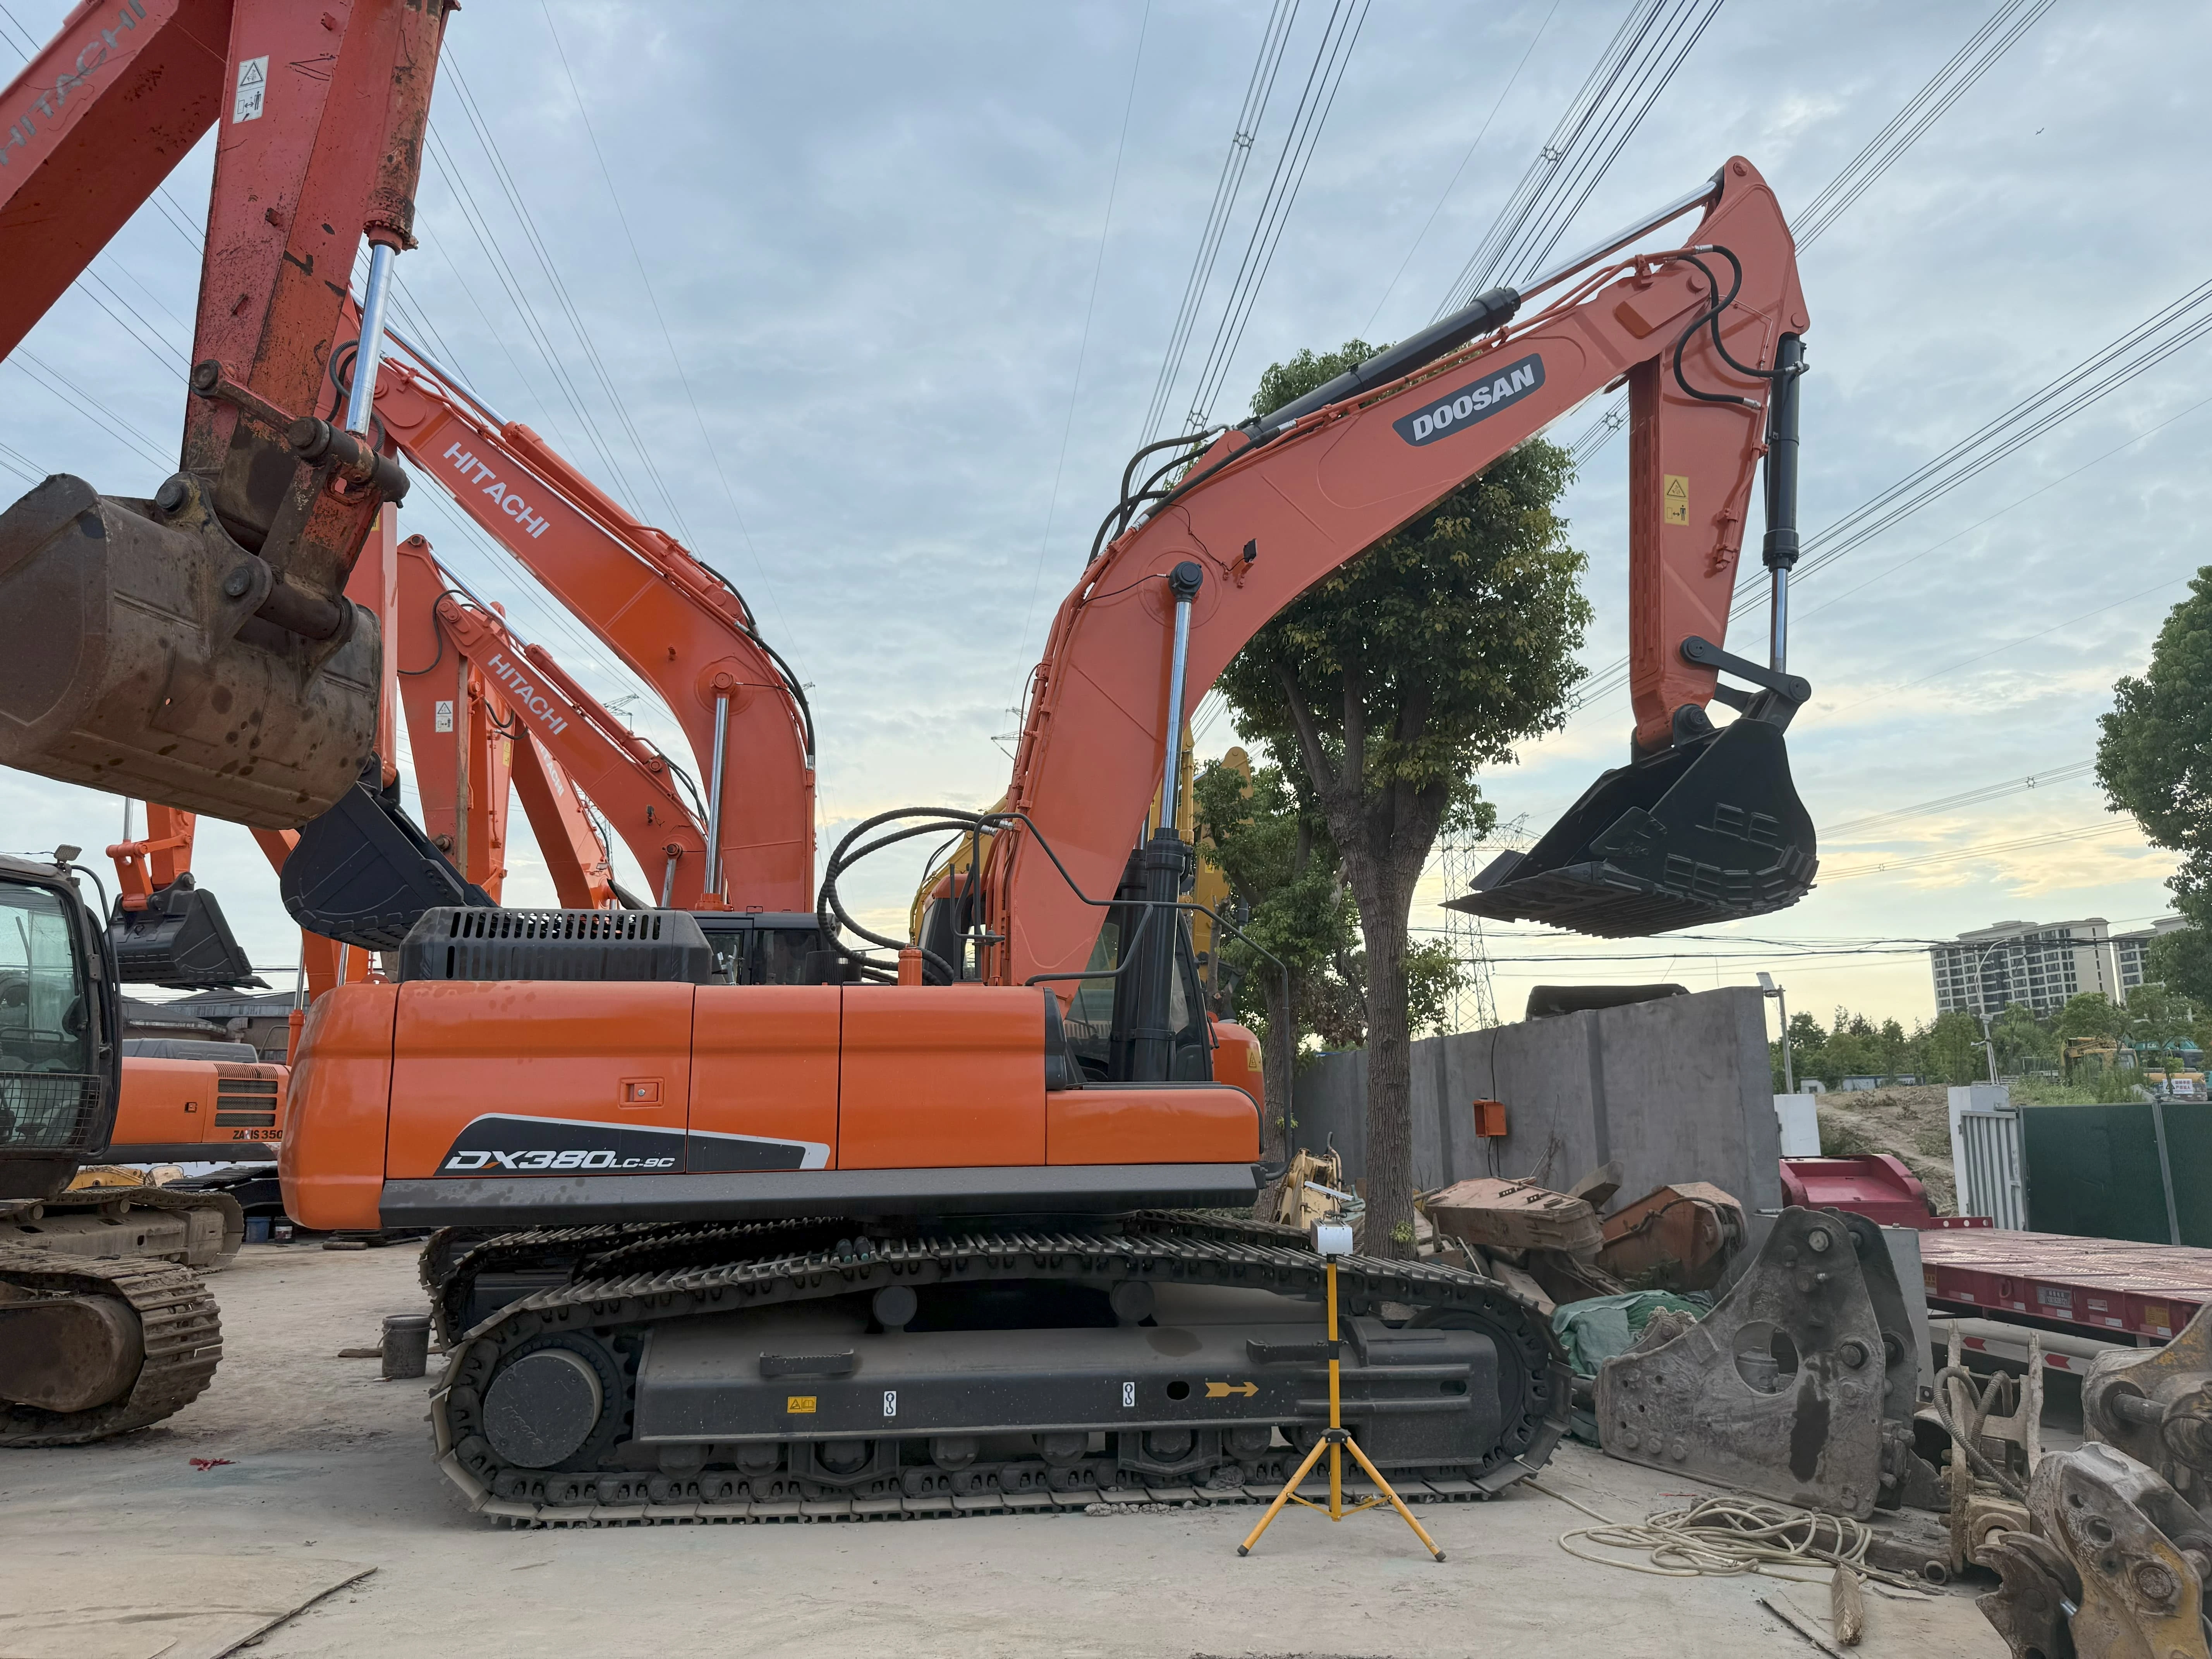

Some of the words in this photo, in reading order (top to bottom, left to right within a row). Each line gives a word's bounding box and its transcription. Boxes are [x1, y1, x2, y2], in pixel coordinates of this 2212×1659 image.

[0, 0, 147, 167] HITACHI
[1413, 364, 1535, 441] DOOSAN
[443, 441, 550, 539] HITACHI
[488, 653, 568, 735] HITACHI
[261, 1130, 283, 1139] 350
